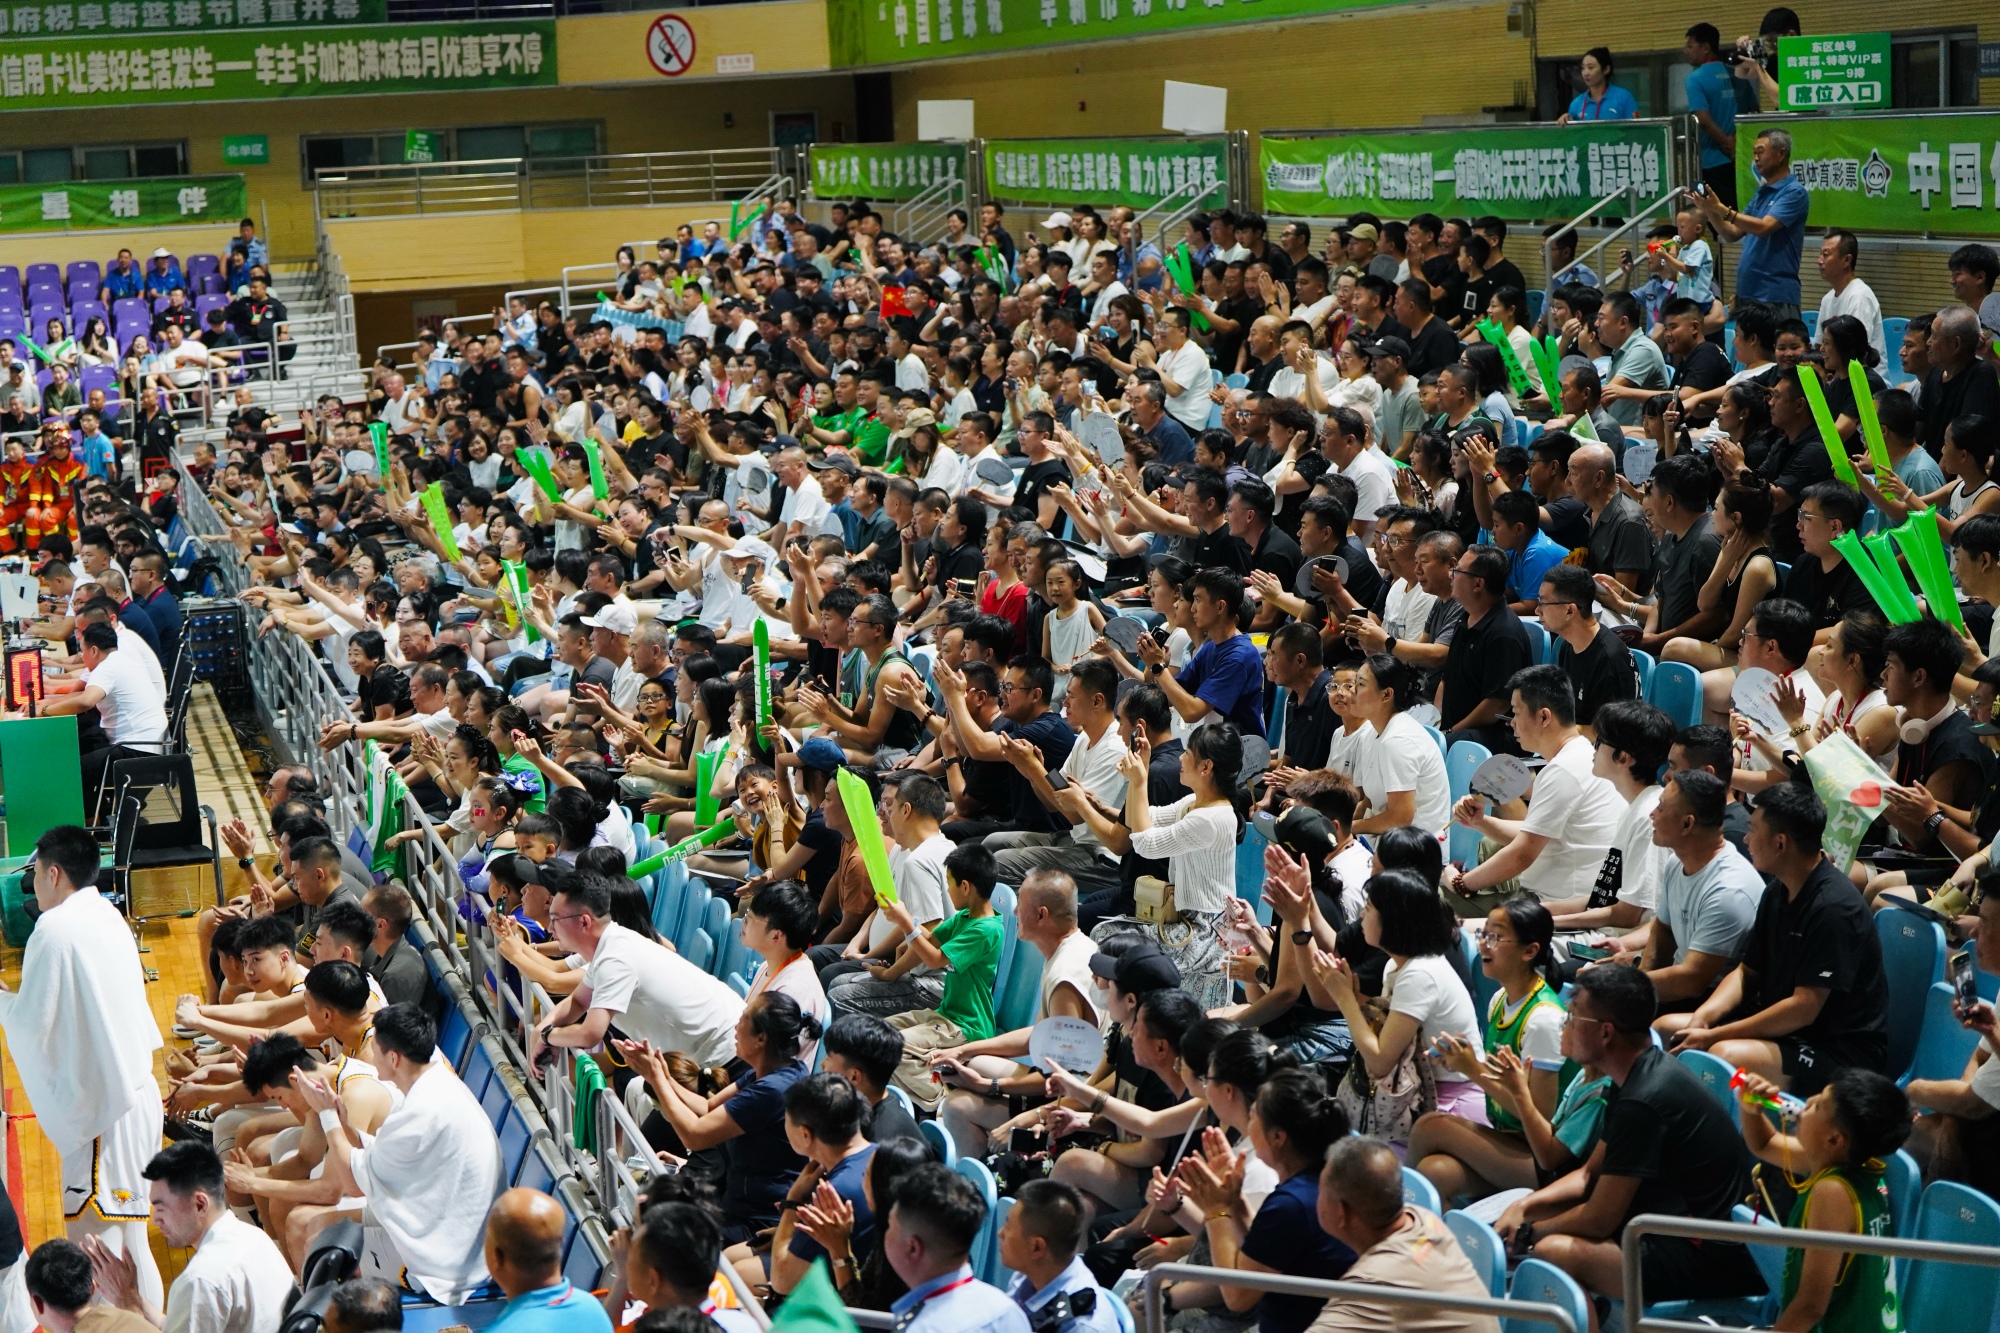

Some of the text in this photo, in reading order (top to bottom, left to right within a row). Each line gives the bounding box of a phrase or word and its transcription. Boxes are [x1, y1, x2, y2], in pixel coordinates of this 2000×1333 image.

[1811, 40, 1857, 53] 东区单号
[1795, 84, 1875, 103] 席位入口
[1907, 141, 2000, 211] 中国
